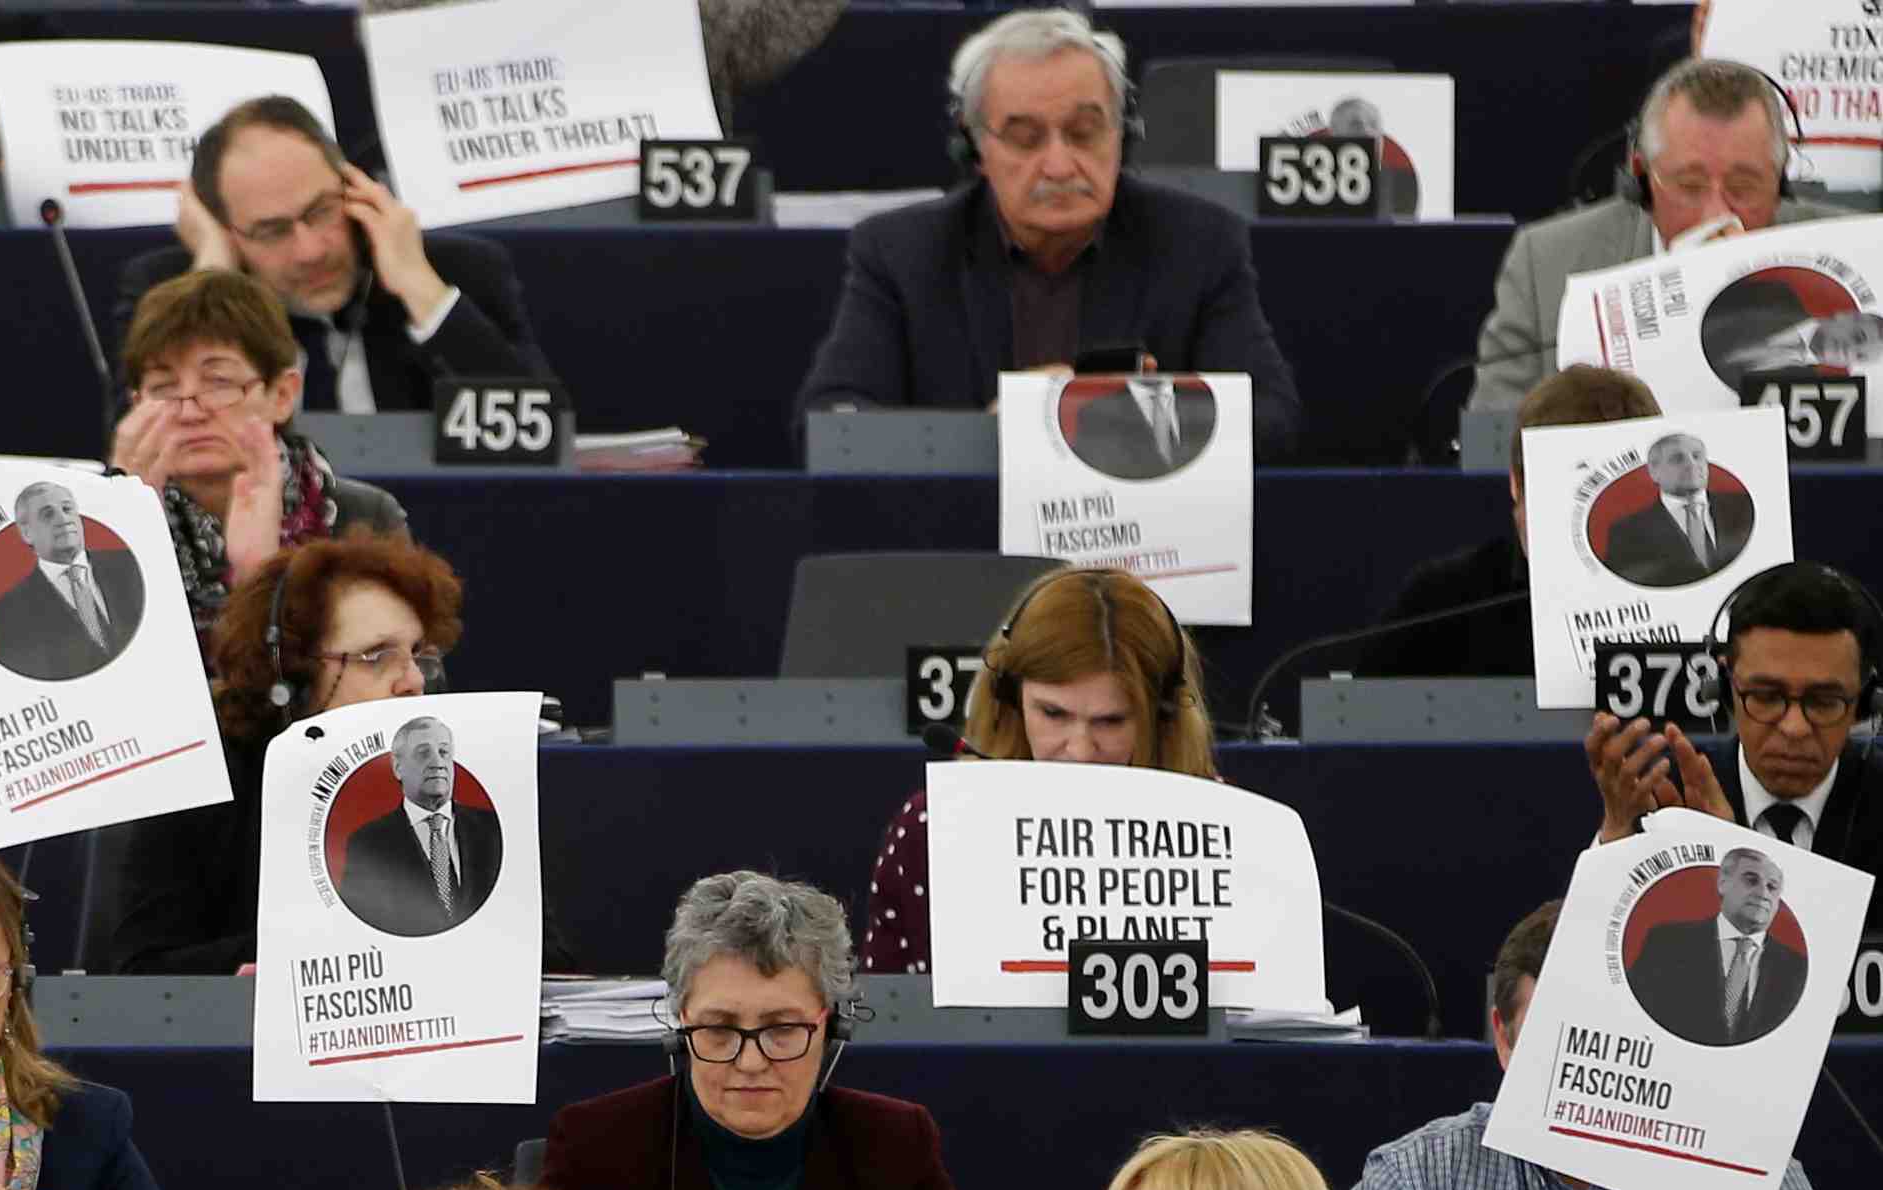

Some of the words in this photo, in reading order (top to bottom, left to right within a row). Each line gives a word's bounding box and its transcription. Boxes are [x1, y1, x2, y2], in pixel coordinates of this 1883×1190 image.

[1830, 26, 1883, 50] TOX
[1781, 55, 1883, 81] CHEMIC
[60, 108, 98, 132] NO
[103, 105, 189, 132] TALKS
[440, 99, 479, 132] NO
[484, 88, 569, 125] TALKS
[1830, 88, 1883, 120] THA
[64, 137, 157, 163] UNDER
[448, 131, 541, 165] UNDER
[646, 148, 751, 208] 537
[1267, 144, 1371, 205] 538
[444, 389, 553, 451] 455
[1041, 500, 1079, 525] MAI
[1046, 522, 1142, 556] FASCISMO
[1574, 609, 1614, 631] MAI
[919, 656, 984, 720] 37
[1608, 653, 1719, 718] 378
[22, 695, 59, 731] PIÙ
[4, 737, 142, 803] #TAJANIDIMETTITI
[311, 755, 350, 804] ANTONIO
[343, 731, 386, 766] TAJANI
[1014, 817, 1095, 858] FAIR
[1104, 818, 1233, 860] TRADE!
[1628, 850, 1675, 889] ANTONIO
[1672, 843, 1716, 865] TAJANI
[1019, 867, 1087, 907] FOR
[1098, 867, 1233, 908] PEOPLE
[1042, 915, 1065, 951] &
[1076, 916, 1214, 943] PLANET
[300, 953, 342, 987] MAI
[348, 945, 385, 981] PIÙ
[1081, 953, 1200, 1020] 303
[303, 983, 414, 1023] FASCISMO
[308, 1016, 457, 1054] #TAJANIDIMETTITI
[1565, 1026, 1611, 1061] MAI
[1614, 1035, 1655, 1069] PIÙ
[1558, 1062, 1673, 1110] FASCISMO
[1554, 1100, 1707, 1150] #TAJANIDIMETTITI
